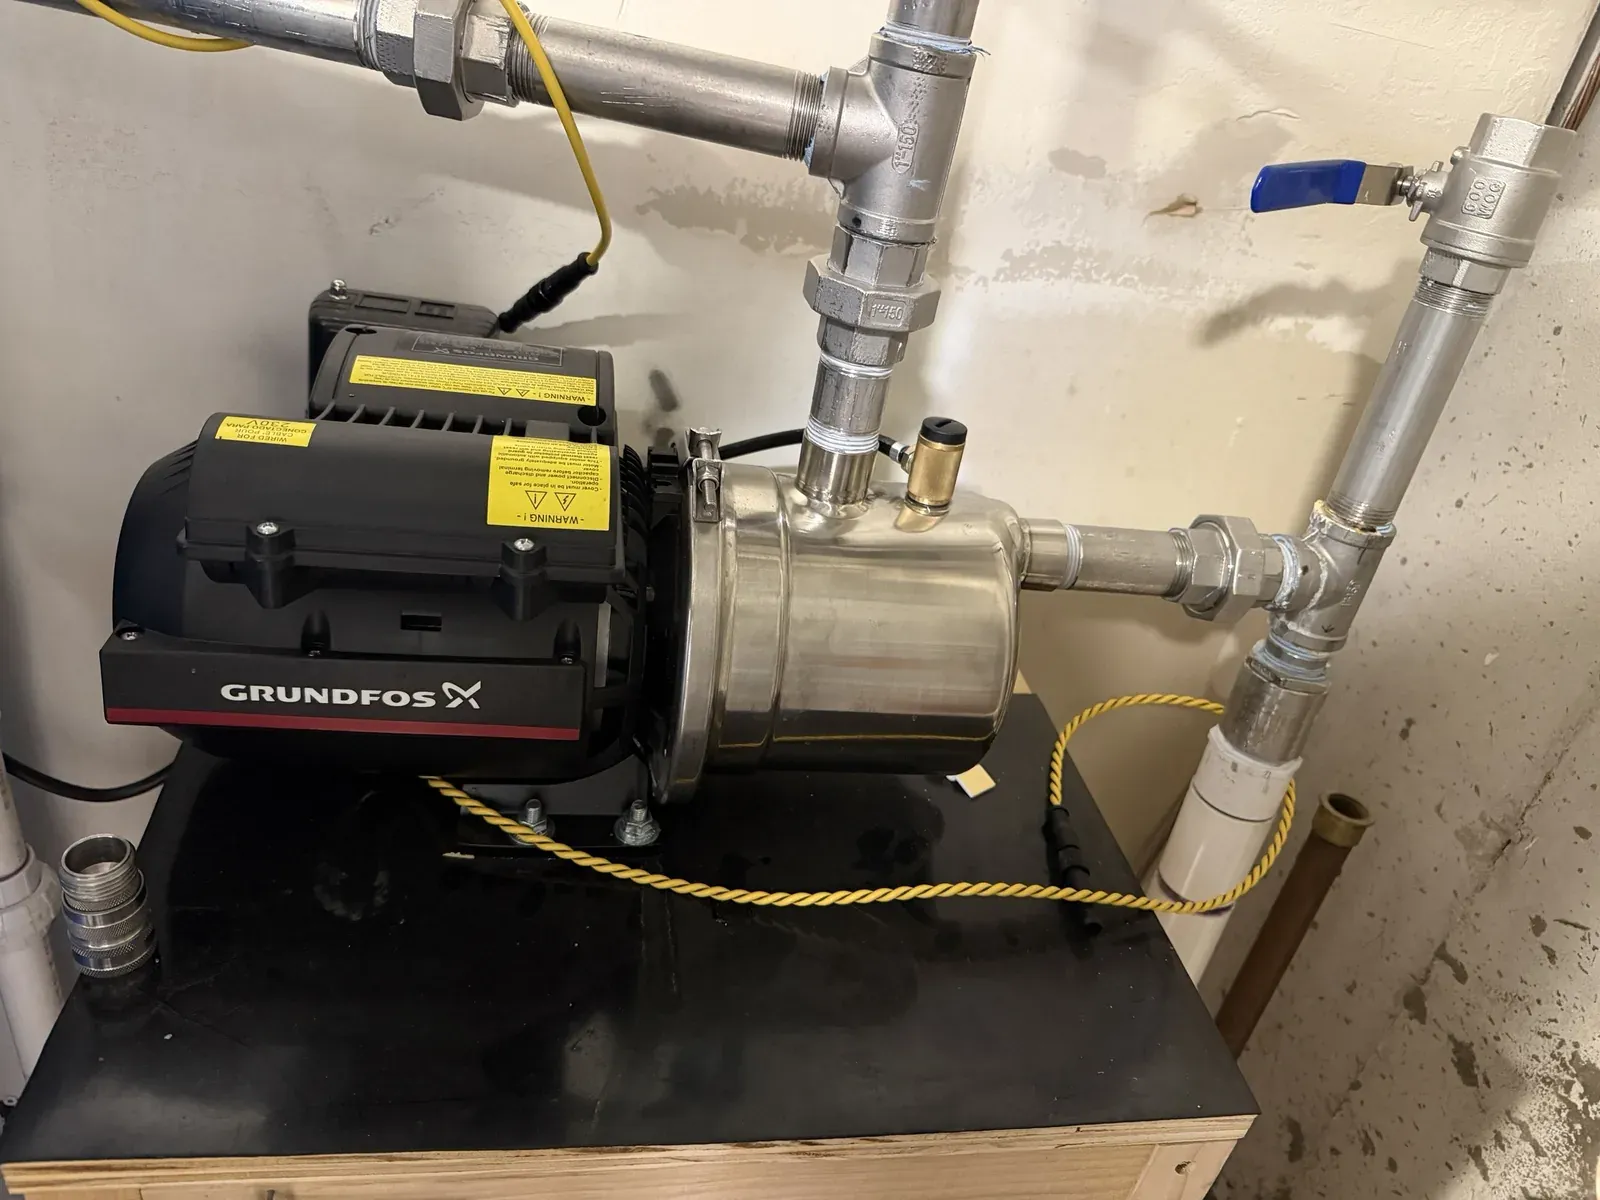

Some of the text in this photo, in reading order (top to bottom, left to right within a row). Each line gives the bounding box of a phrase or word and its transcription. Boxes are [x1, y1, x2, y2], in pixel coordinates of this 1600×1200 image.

[1464, 180, 1486, 212] 600
[544, 392, 586, 402] WARNING
[246, 420, 291, 428] 230V
[252, 425, 307, 434] CONECTADO
[530, 514, 579, 524] WARNING
[220, 684, 436, 708] GRUNDFOS
